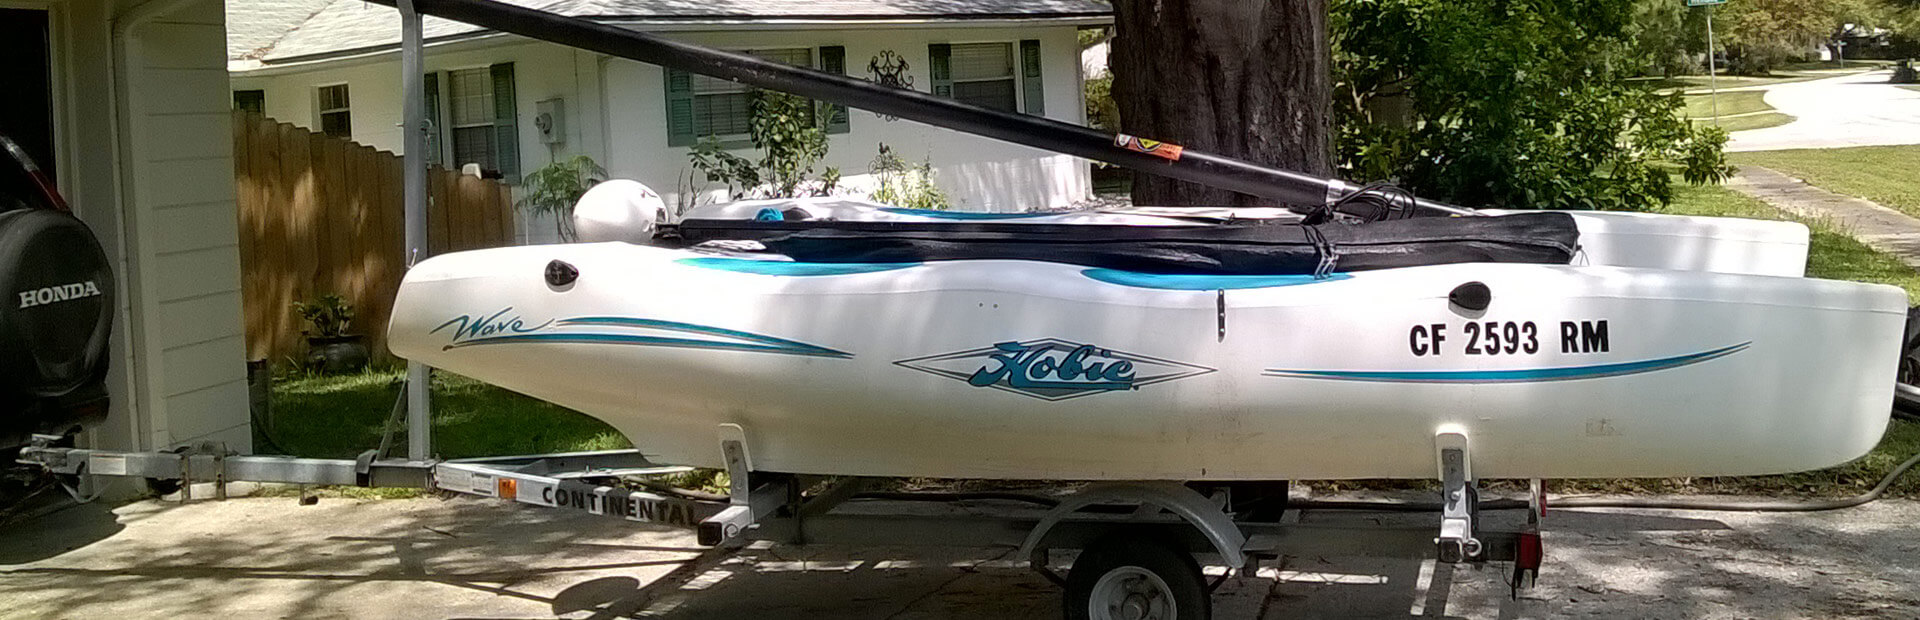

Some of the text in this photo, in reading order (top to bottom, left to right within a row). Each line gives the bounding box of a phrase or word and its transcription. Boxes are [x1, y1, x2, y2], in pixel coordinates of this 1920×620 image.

[19, 281, 101, 309] HONDA
[429, 306, 555, 341] Wave
[1409, 320, 1610, 357] CF 2593 RM
[967, 341, 1137, 391] Hobie
[542, 486, 697, 526] CONTINENTAL
